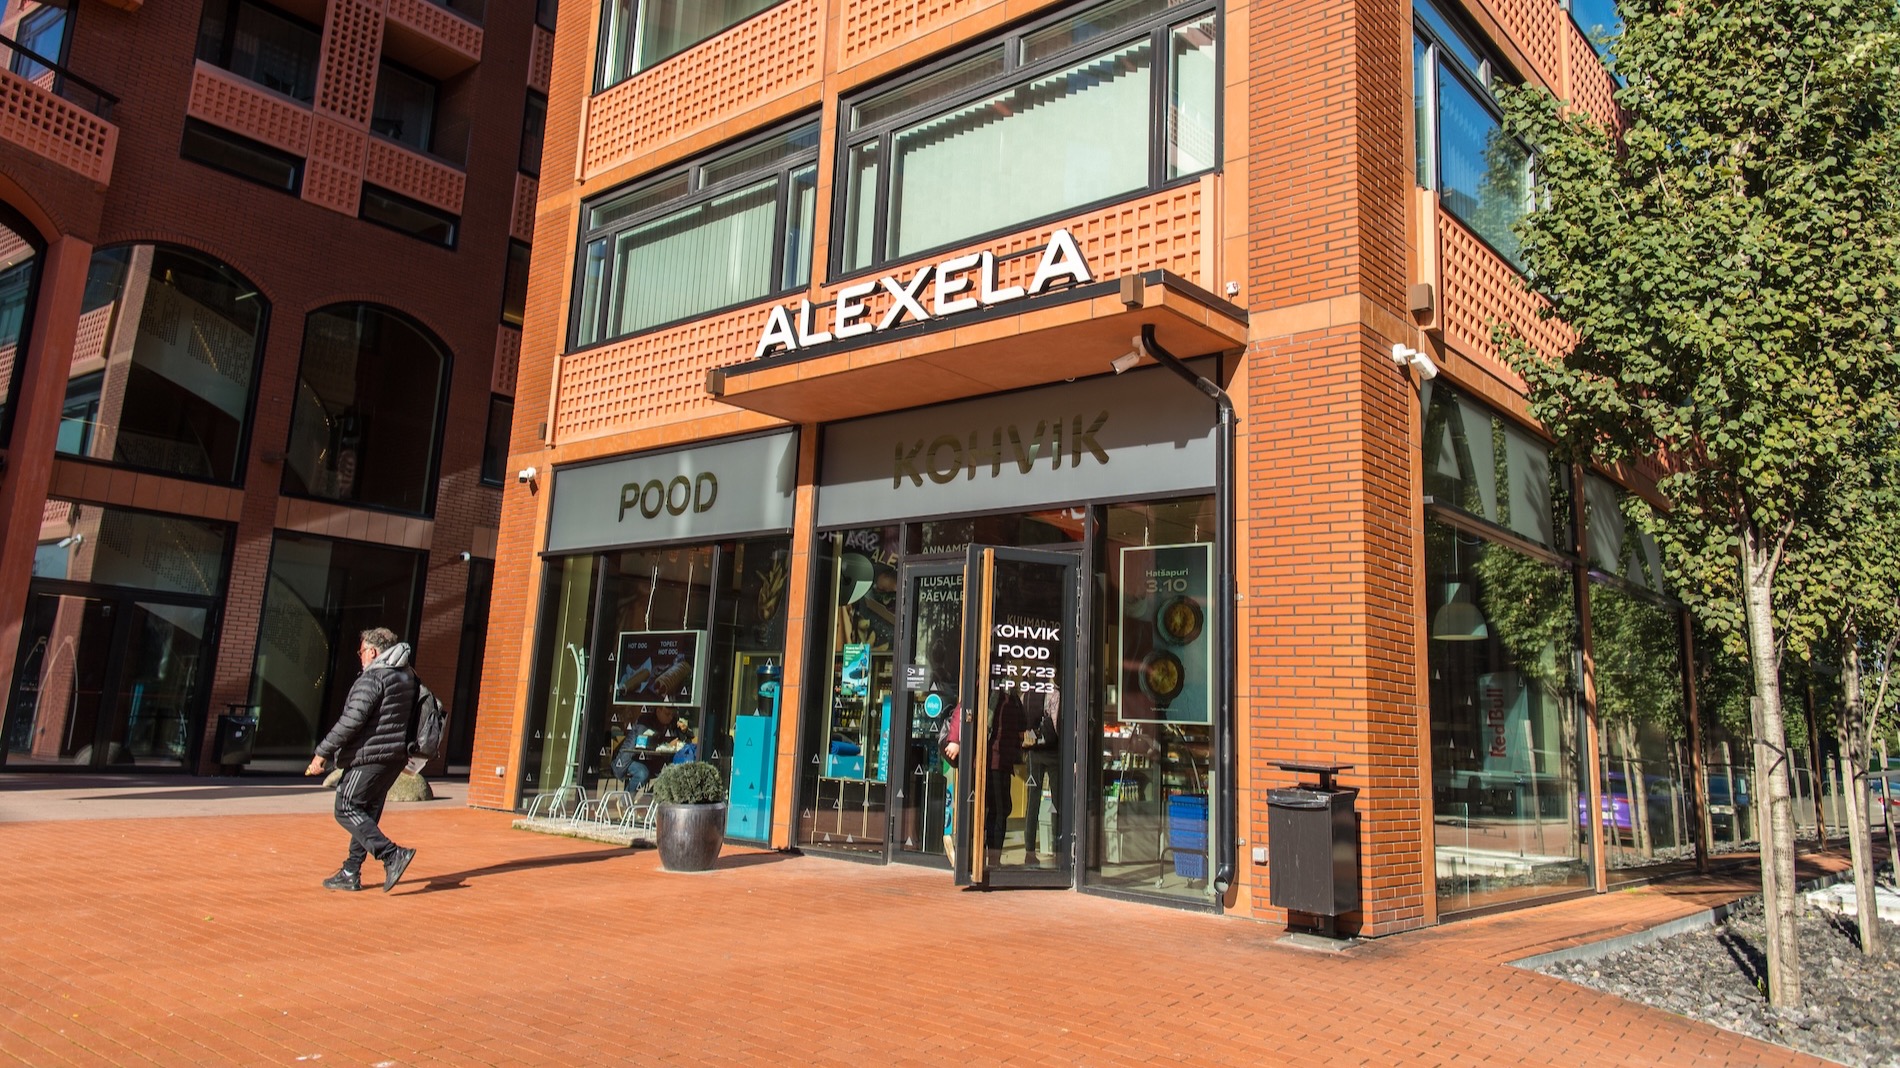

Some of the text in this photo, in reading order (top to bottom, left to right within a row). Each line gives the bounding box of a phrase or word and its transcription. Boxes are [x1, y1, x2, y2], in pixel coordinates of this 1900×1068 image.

[754, 229, 1094, 358] ALEXELA
[893, 410, 1110, 490] KOHVIK
[618, 471, 718, 522] POOD
[871, 547, 899, 571] ALE
[920, 575, 963, 587] ILUSALE
[1146, 578, 1188, 593] 3.10
[919, 589, 964, 602] PÄEVALE
[992, 624, 1060, 641] KOHVIK
[998, 644, 1050, 660] POOD
[991, 664, 1056, 679] E-R 7-23
[1020, 681, 1055, 694] 9-23
